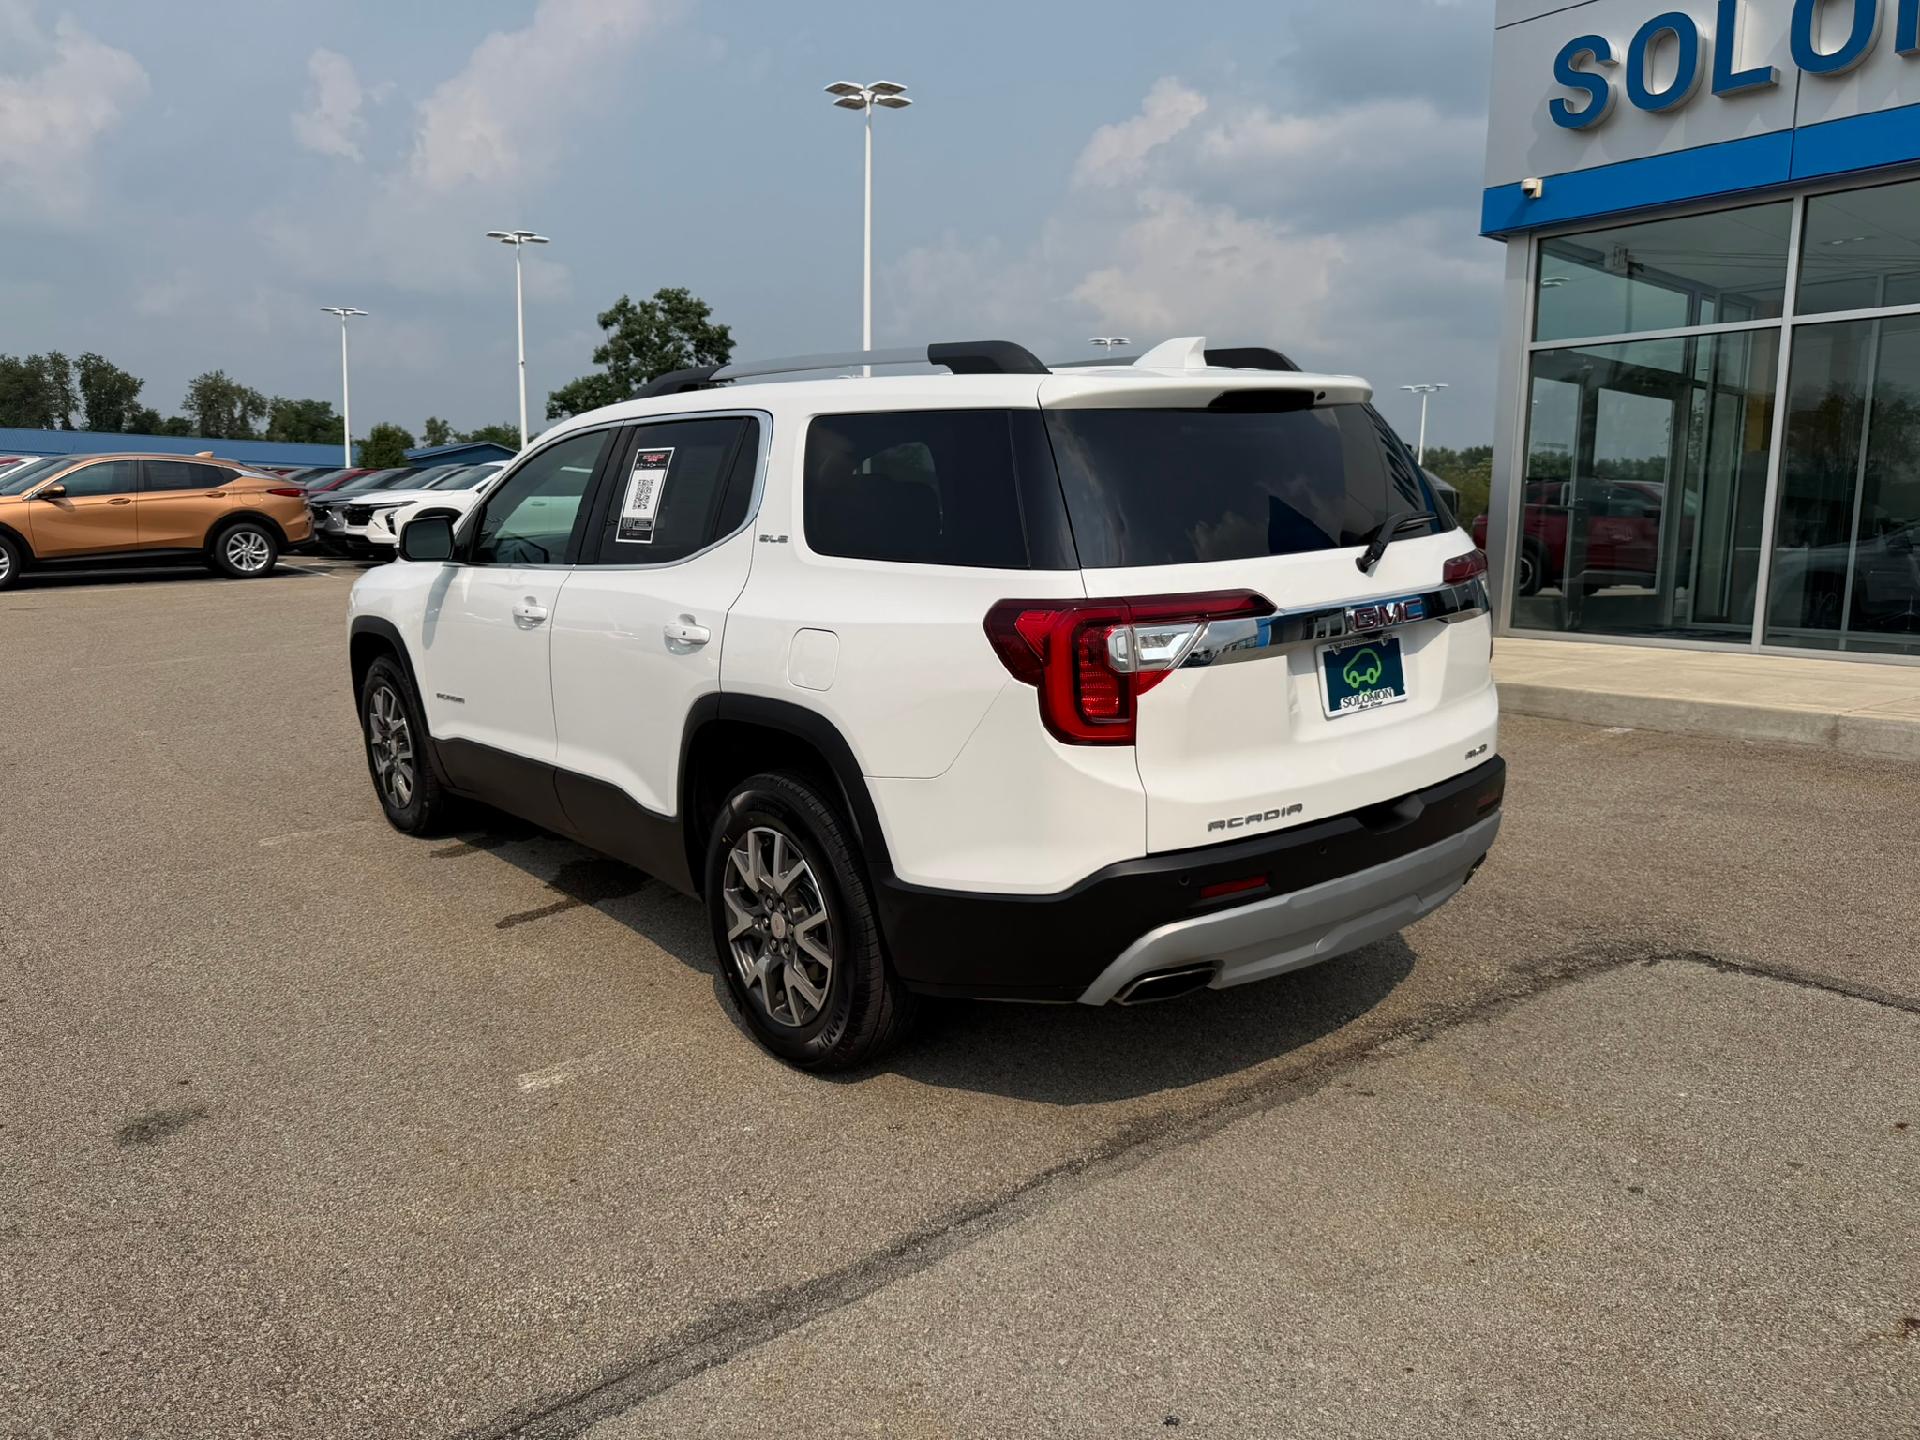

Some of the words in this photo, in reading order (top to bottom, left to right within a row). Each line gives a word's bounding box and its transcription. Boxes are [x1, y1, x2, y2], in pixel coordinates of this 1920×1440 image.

[1549, 0, 1920, 129] SOLO
[1353, 599, 1424, 632] GMC
[1342, 687, 1392, 709] SOLOMON
[1207, 802, 1304, 833] ACADIA
